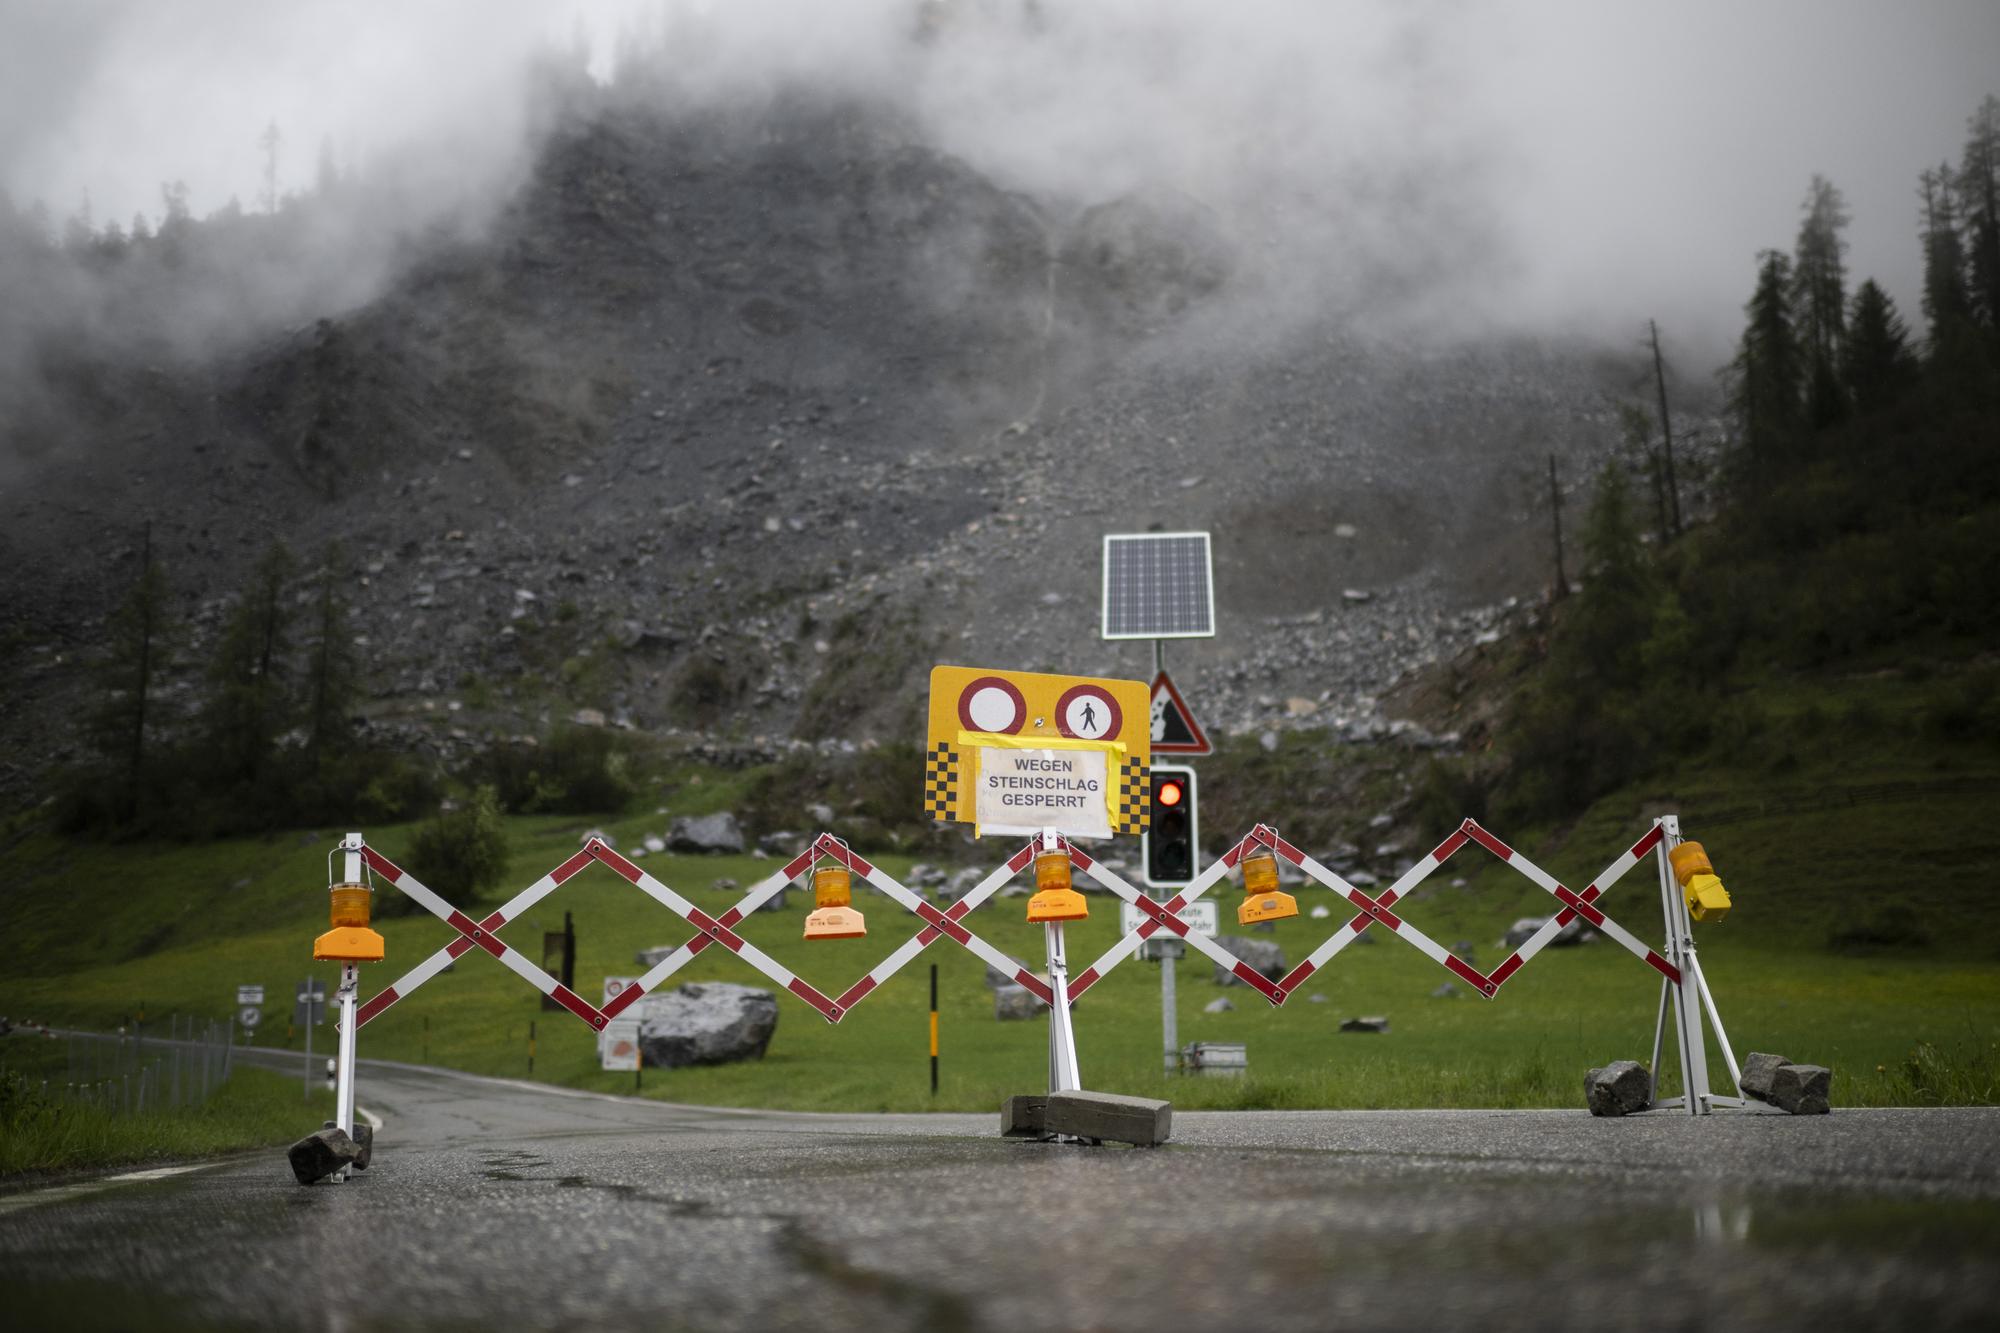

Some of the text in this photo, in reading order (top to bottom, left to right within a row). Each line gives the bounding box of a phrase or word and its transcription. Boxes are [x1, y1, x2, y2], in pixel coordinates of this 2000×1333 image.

[1015, 758, 1072, 772] WEGEN
[989, 776, 1098, 791] STEINSCHLAG
[1002, 793, 1086, 808] GESPERRT
